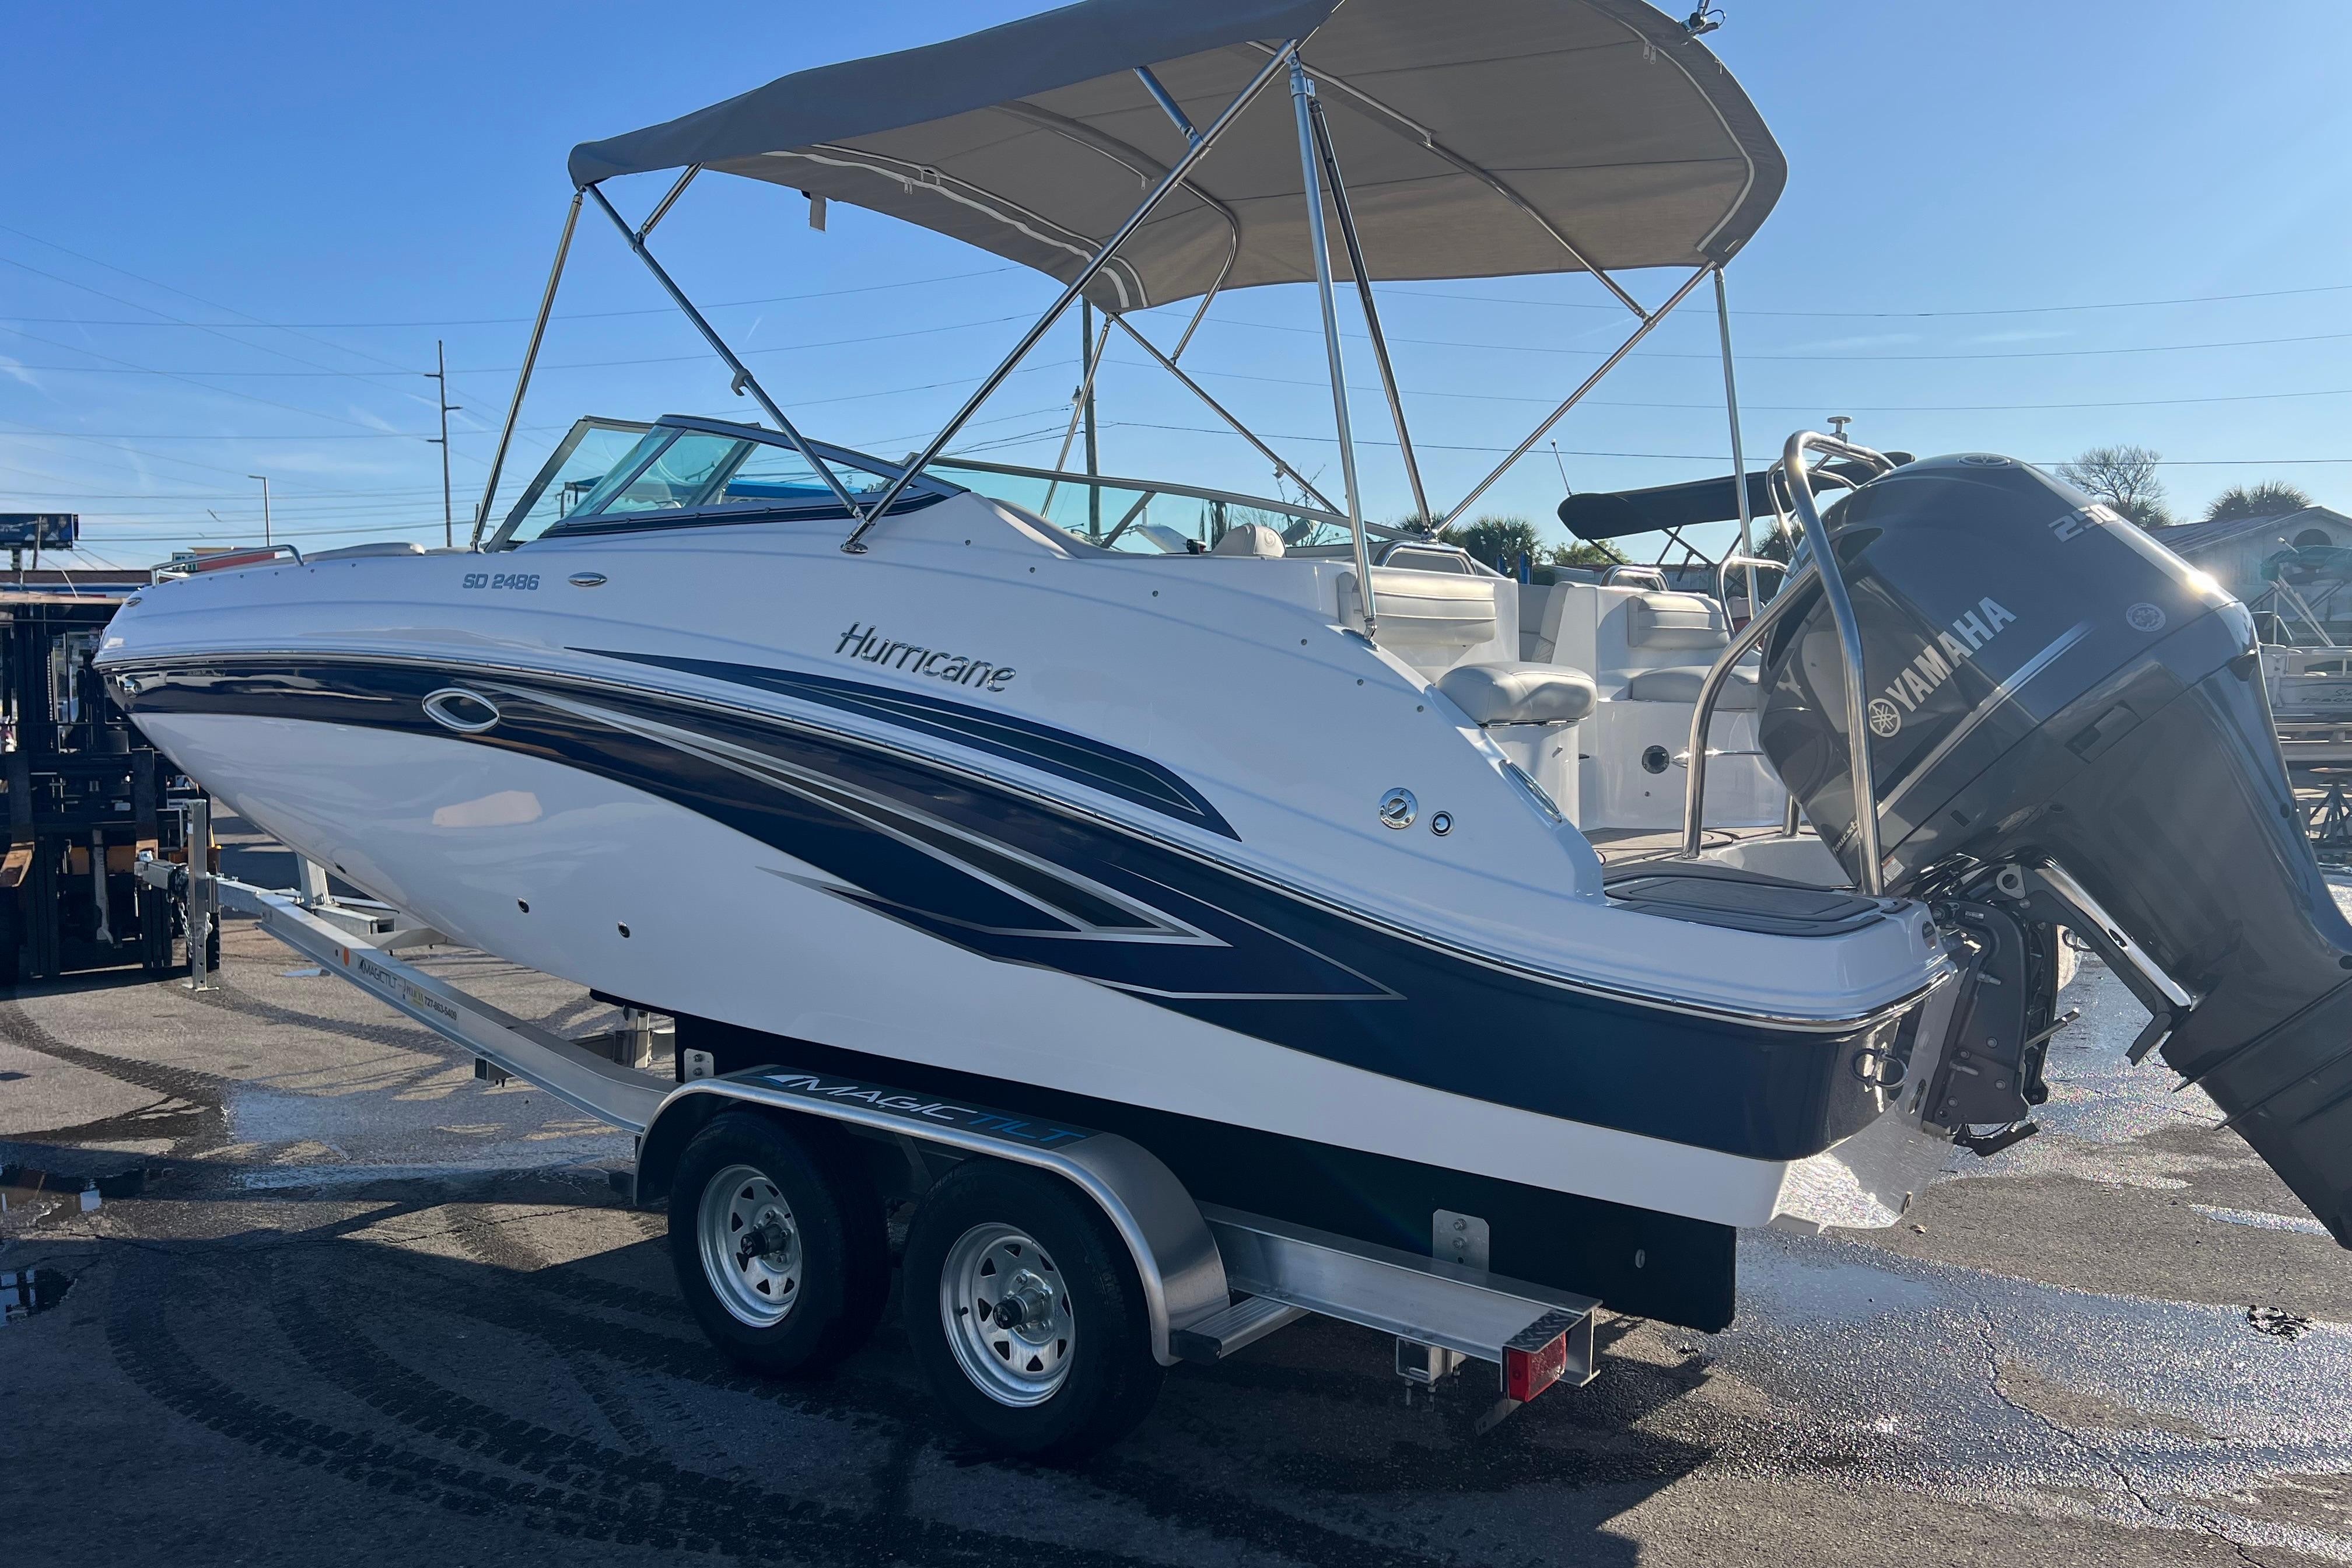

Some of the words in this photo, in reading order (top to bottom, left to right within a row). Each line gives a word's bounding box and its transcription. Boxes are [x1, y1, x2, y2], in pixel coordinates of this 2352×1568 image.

[2048, 504, 2118, 542] 250
[462, 573, 488, 589] SD
[491, 574, 540, 590] 2486
[835, 621, 1016, 692] Hurricane
[1885, 596, 2017, 713] YAMAHA
